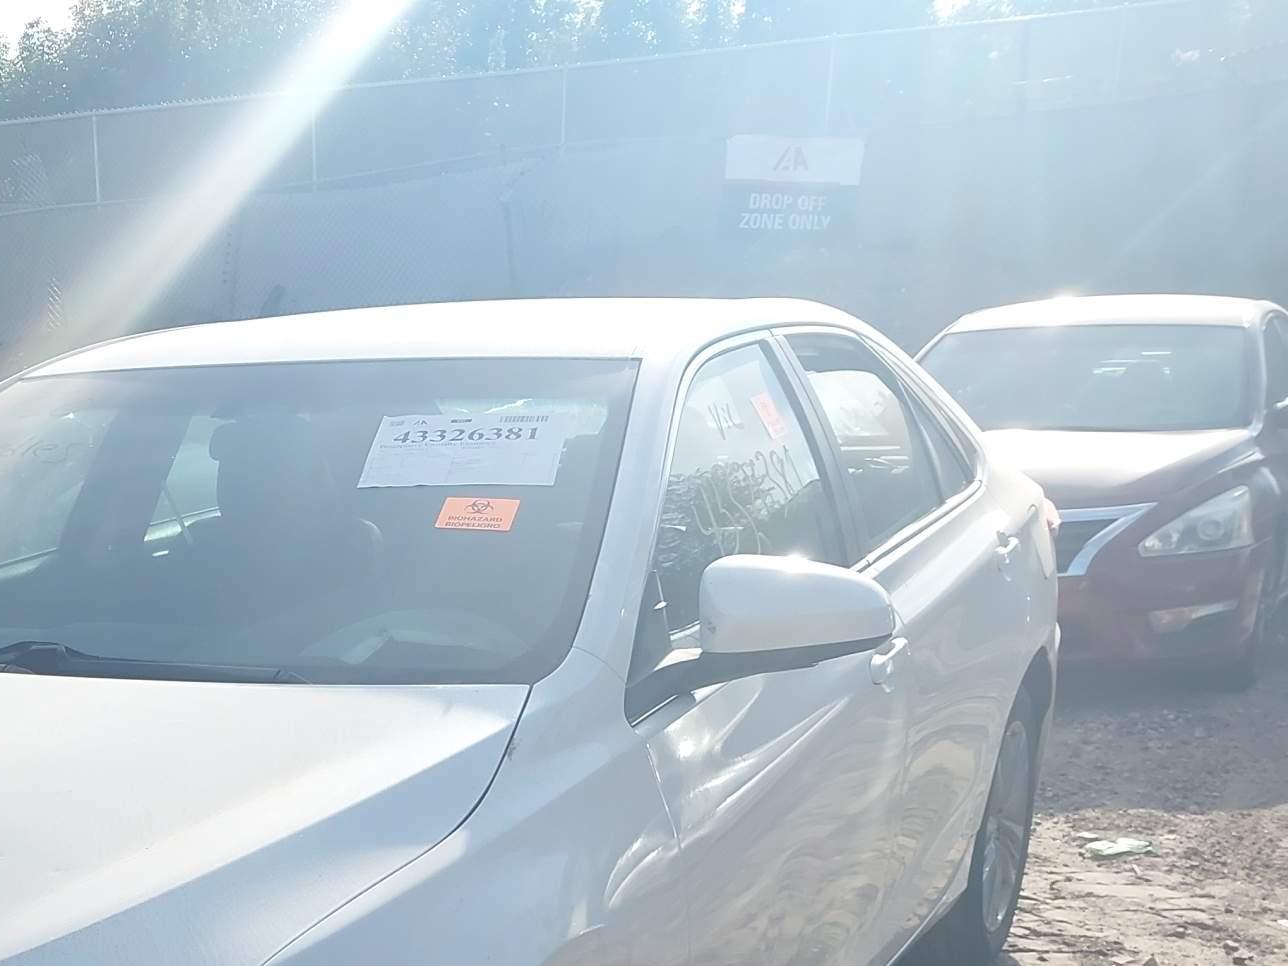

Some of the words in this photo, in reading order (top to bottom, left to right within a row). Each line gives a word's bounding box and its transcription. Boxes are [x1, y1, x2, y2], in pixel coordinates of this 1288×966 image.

[748, 192, 793, 210] DROP
[797, 195, 827, 211] OFF
[738, 213, 785, 230] ZONE
[788, 214, 832, 231] ONLY
[392, 426, 539, 444] 43326381
[447, 515, 504, 523] BIOHAZARD
